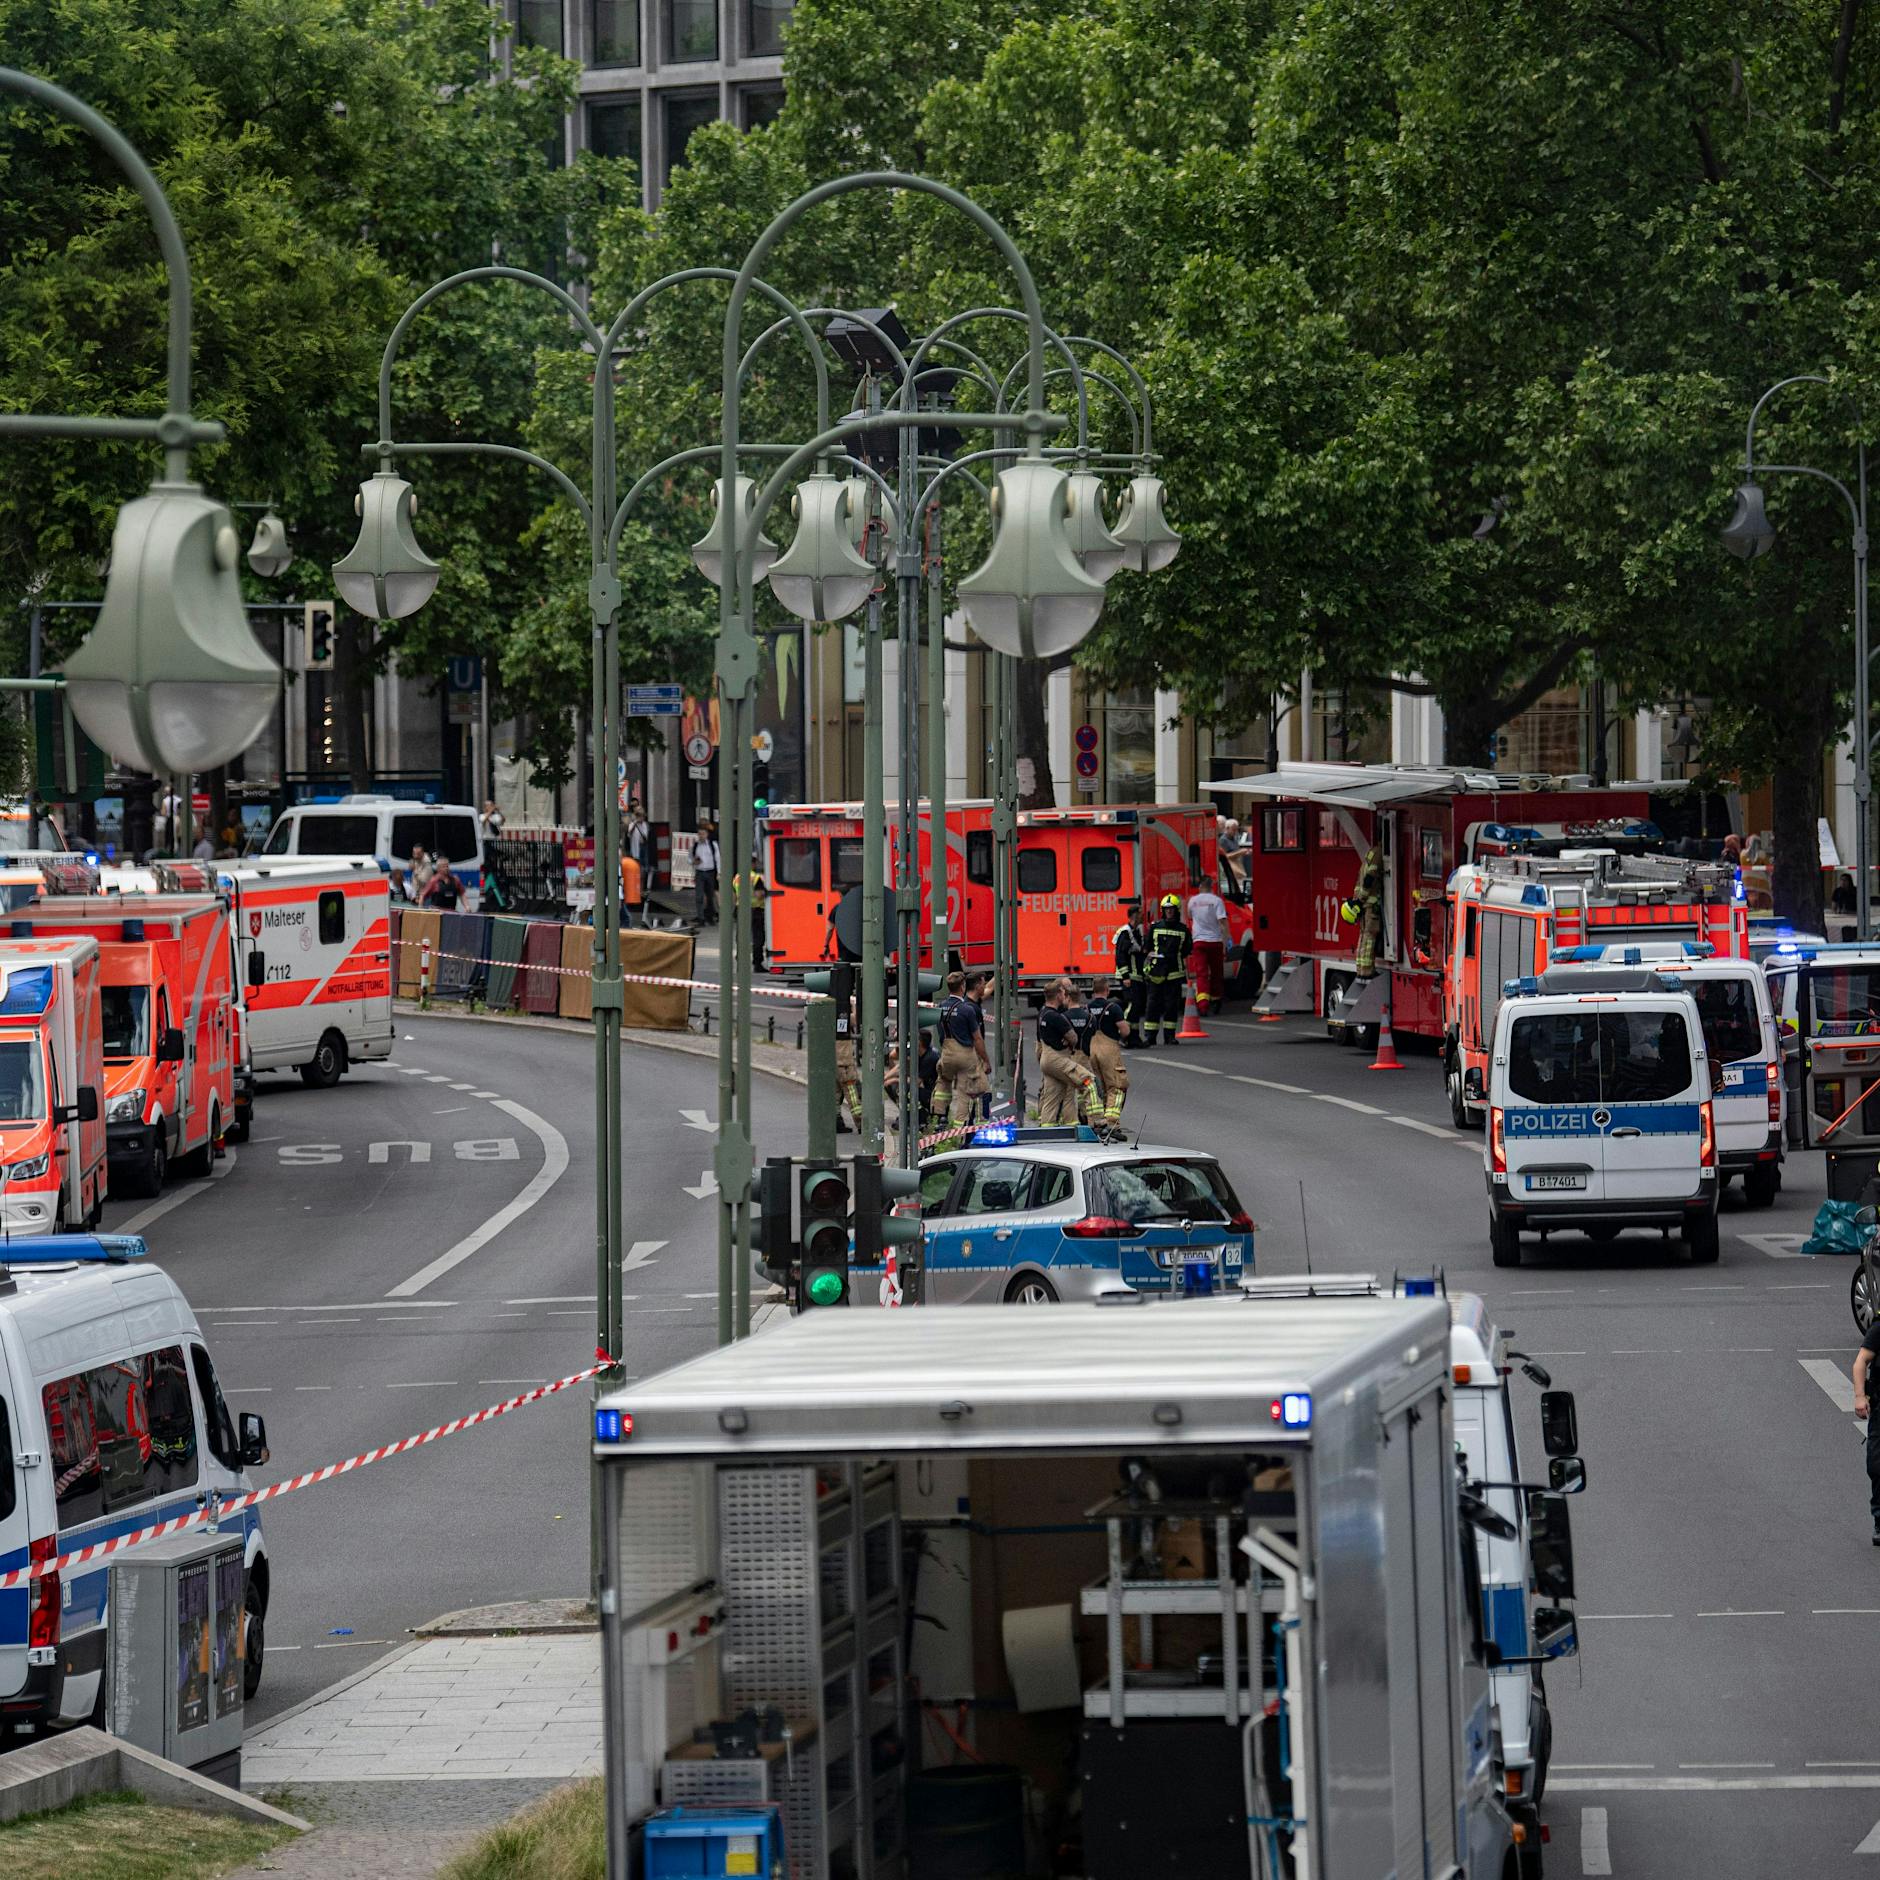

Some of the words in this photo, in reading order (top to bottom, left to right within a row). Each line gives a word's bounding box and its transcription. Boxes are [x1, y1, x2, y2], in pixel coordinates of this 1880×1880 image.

[454, 661, 474, 688] U
[791, 822, 856, 836] FEUERWEHR
[1022, 893, 1119, 913] FEUERWEHR
[264, 908, 307, 929] Malteser
[1314, 895, 1340, 943] 112
[1083, 934, 1115, 956] 11
[274, 964, 292, 980] 112
[327, 979, 385, 996] NOTFALLRETTUNG
[1511, 1113, 1587, 1131] POLIZEI
[1539, 1177, 1546, 1187] B
[1552, 1176, 1577, 1187] 7401
